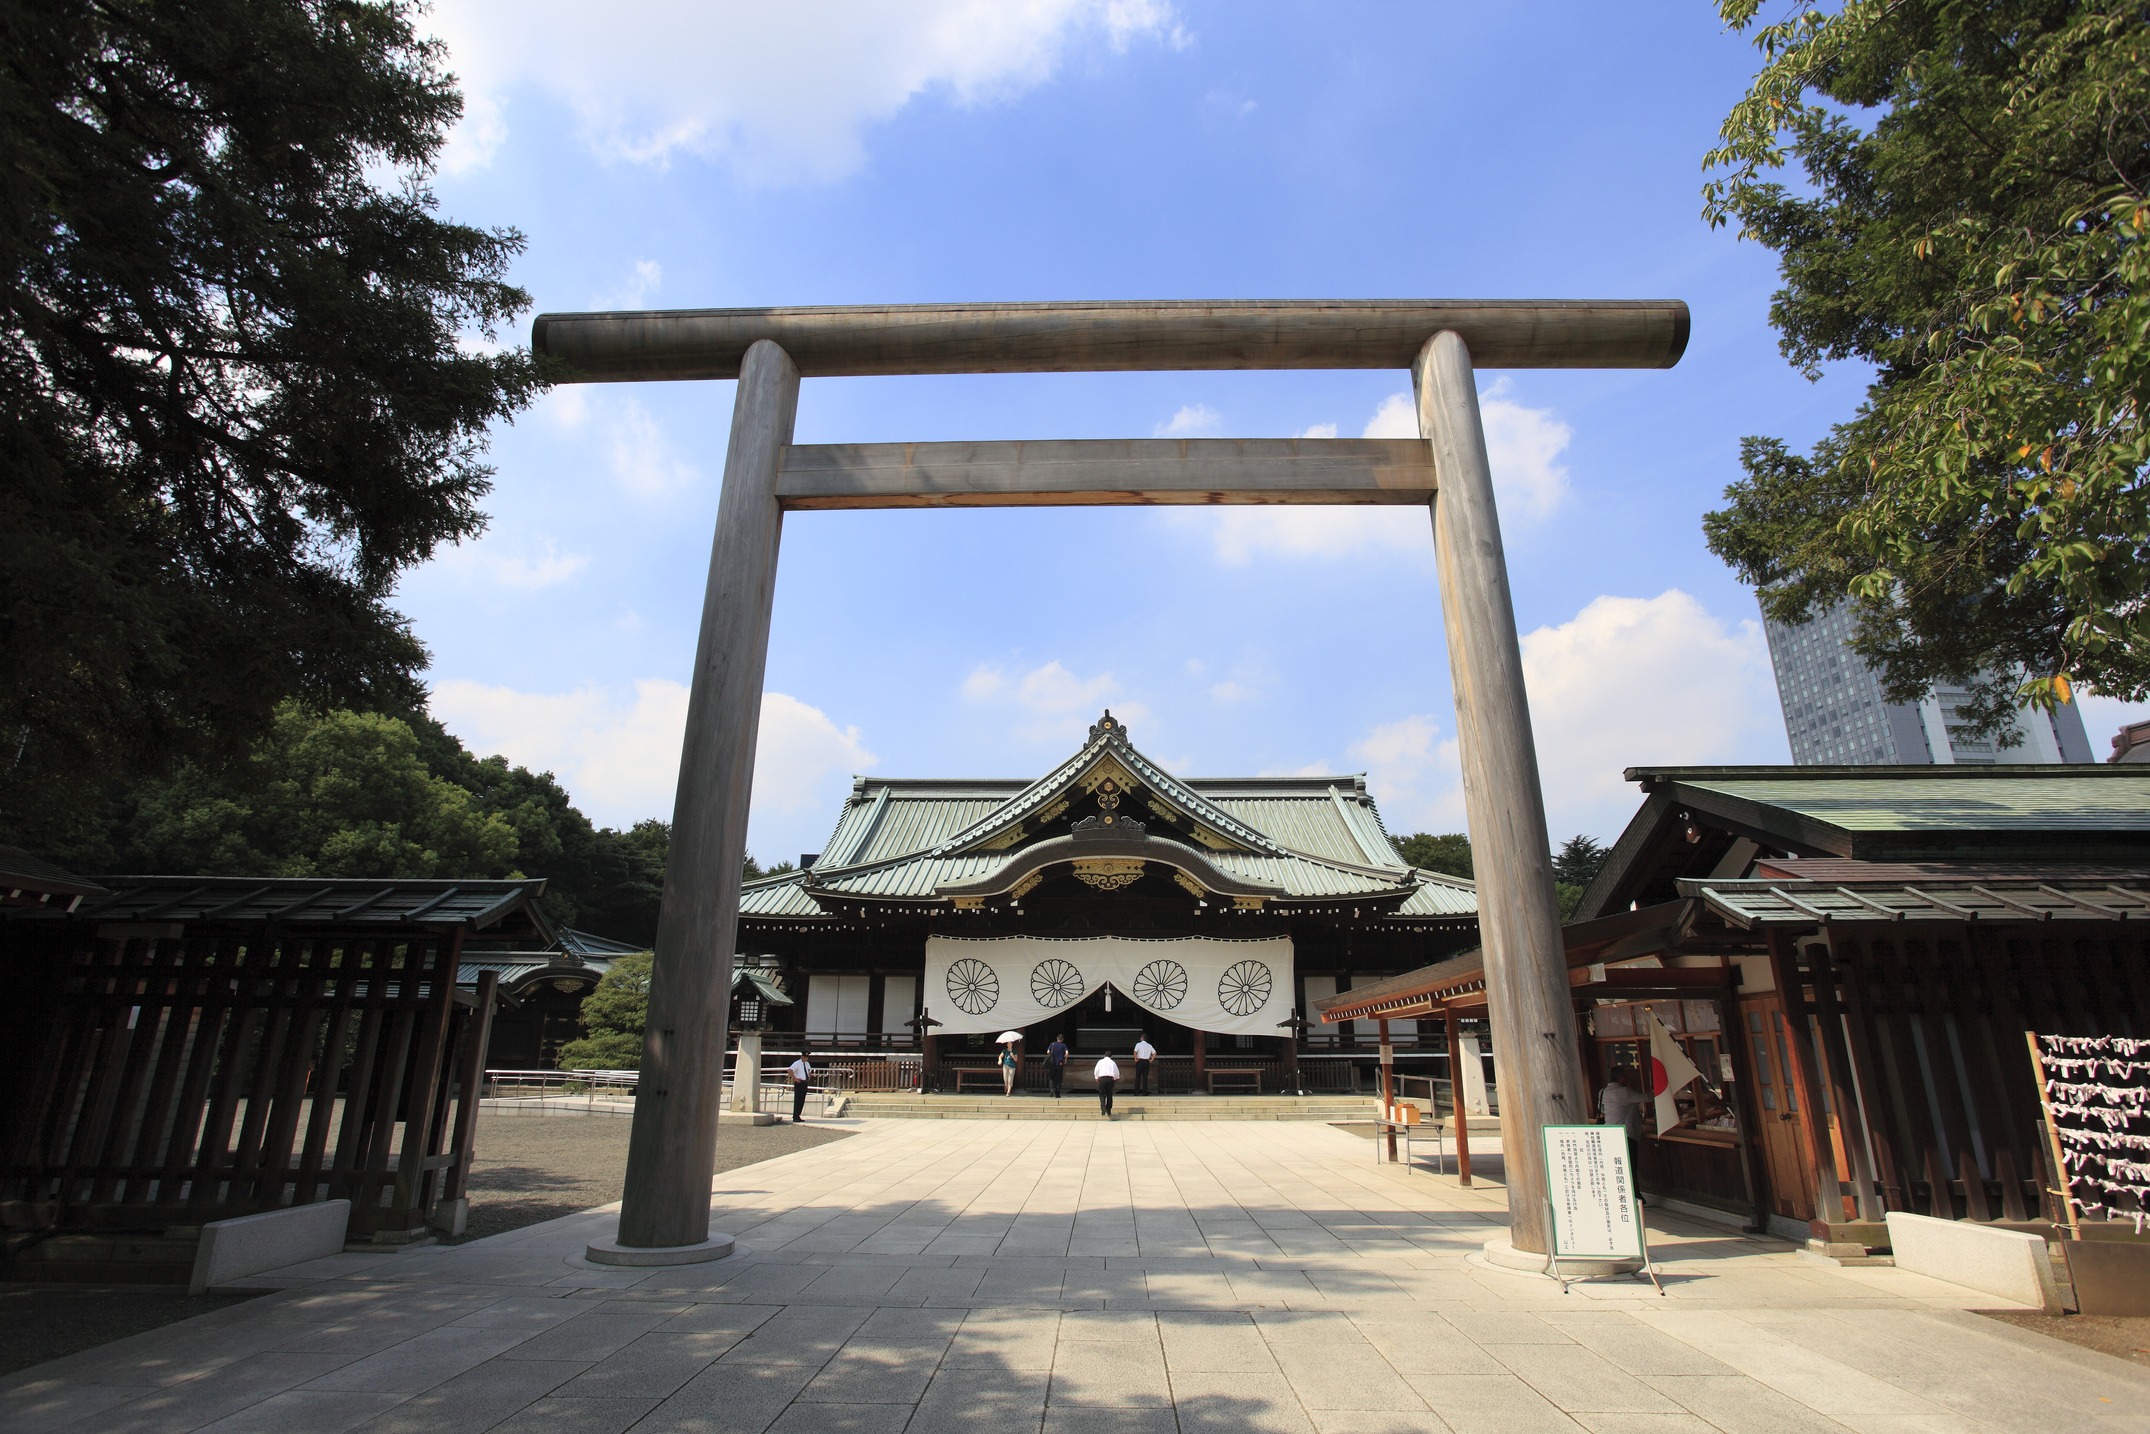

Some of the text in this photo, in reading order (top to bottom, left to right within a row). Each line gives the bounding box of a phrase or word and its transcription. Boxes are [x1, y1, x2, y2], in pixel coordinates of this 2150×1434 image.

[1614, 1157, 1629, 1222] 報道関係者各位
